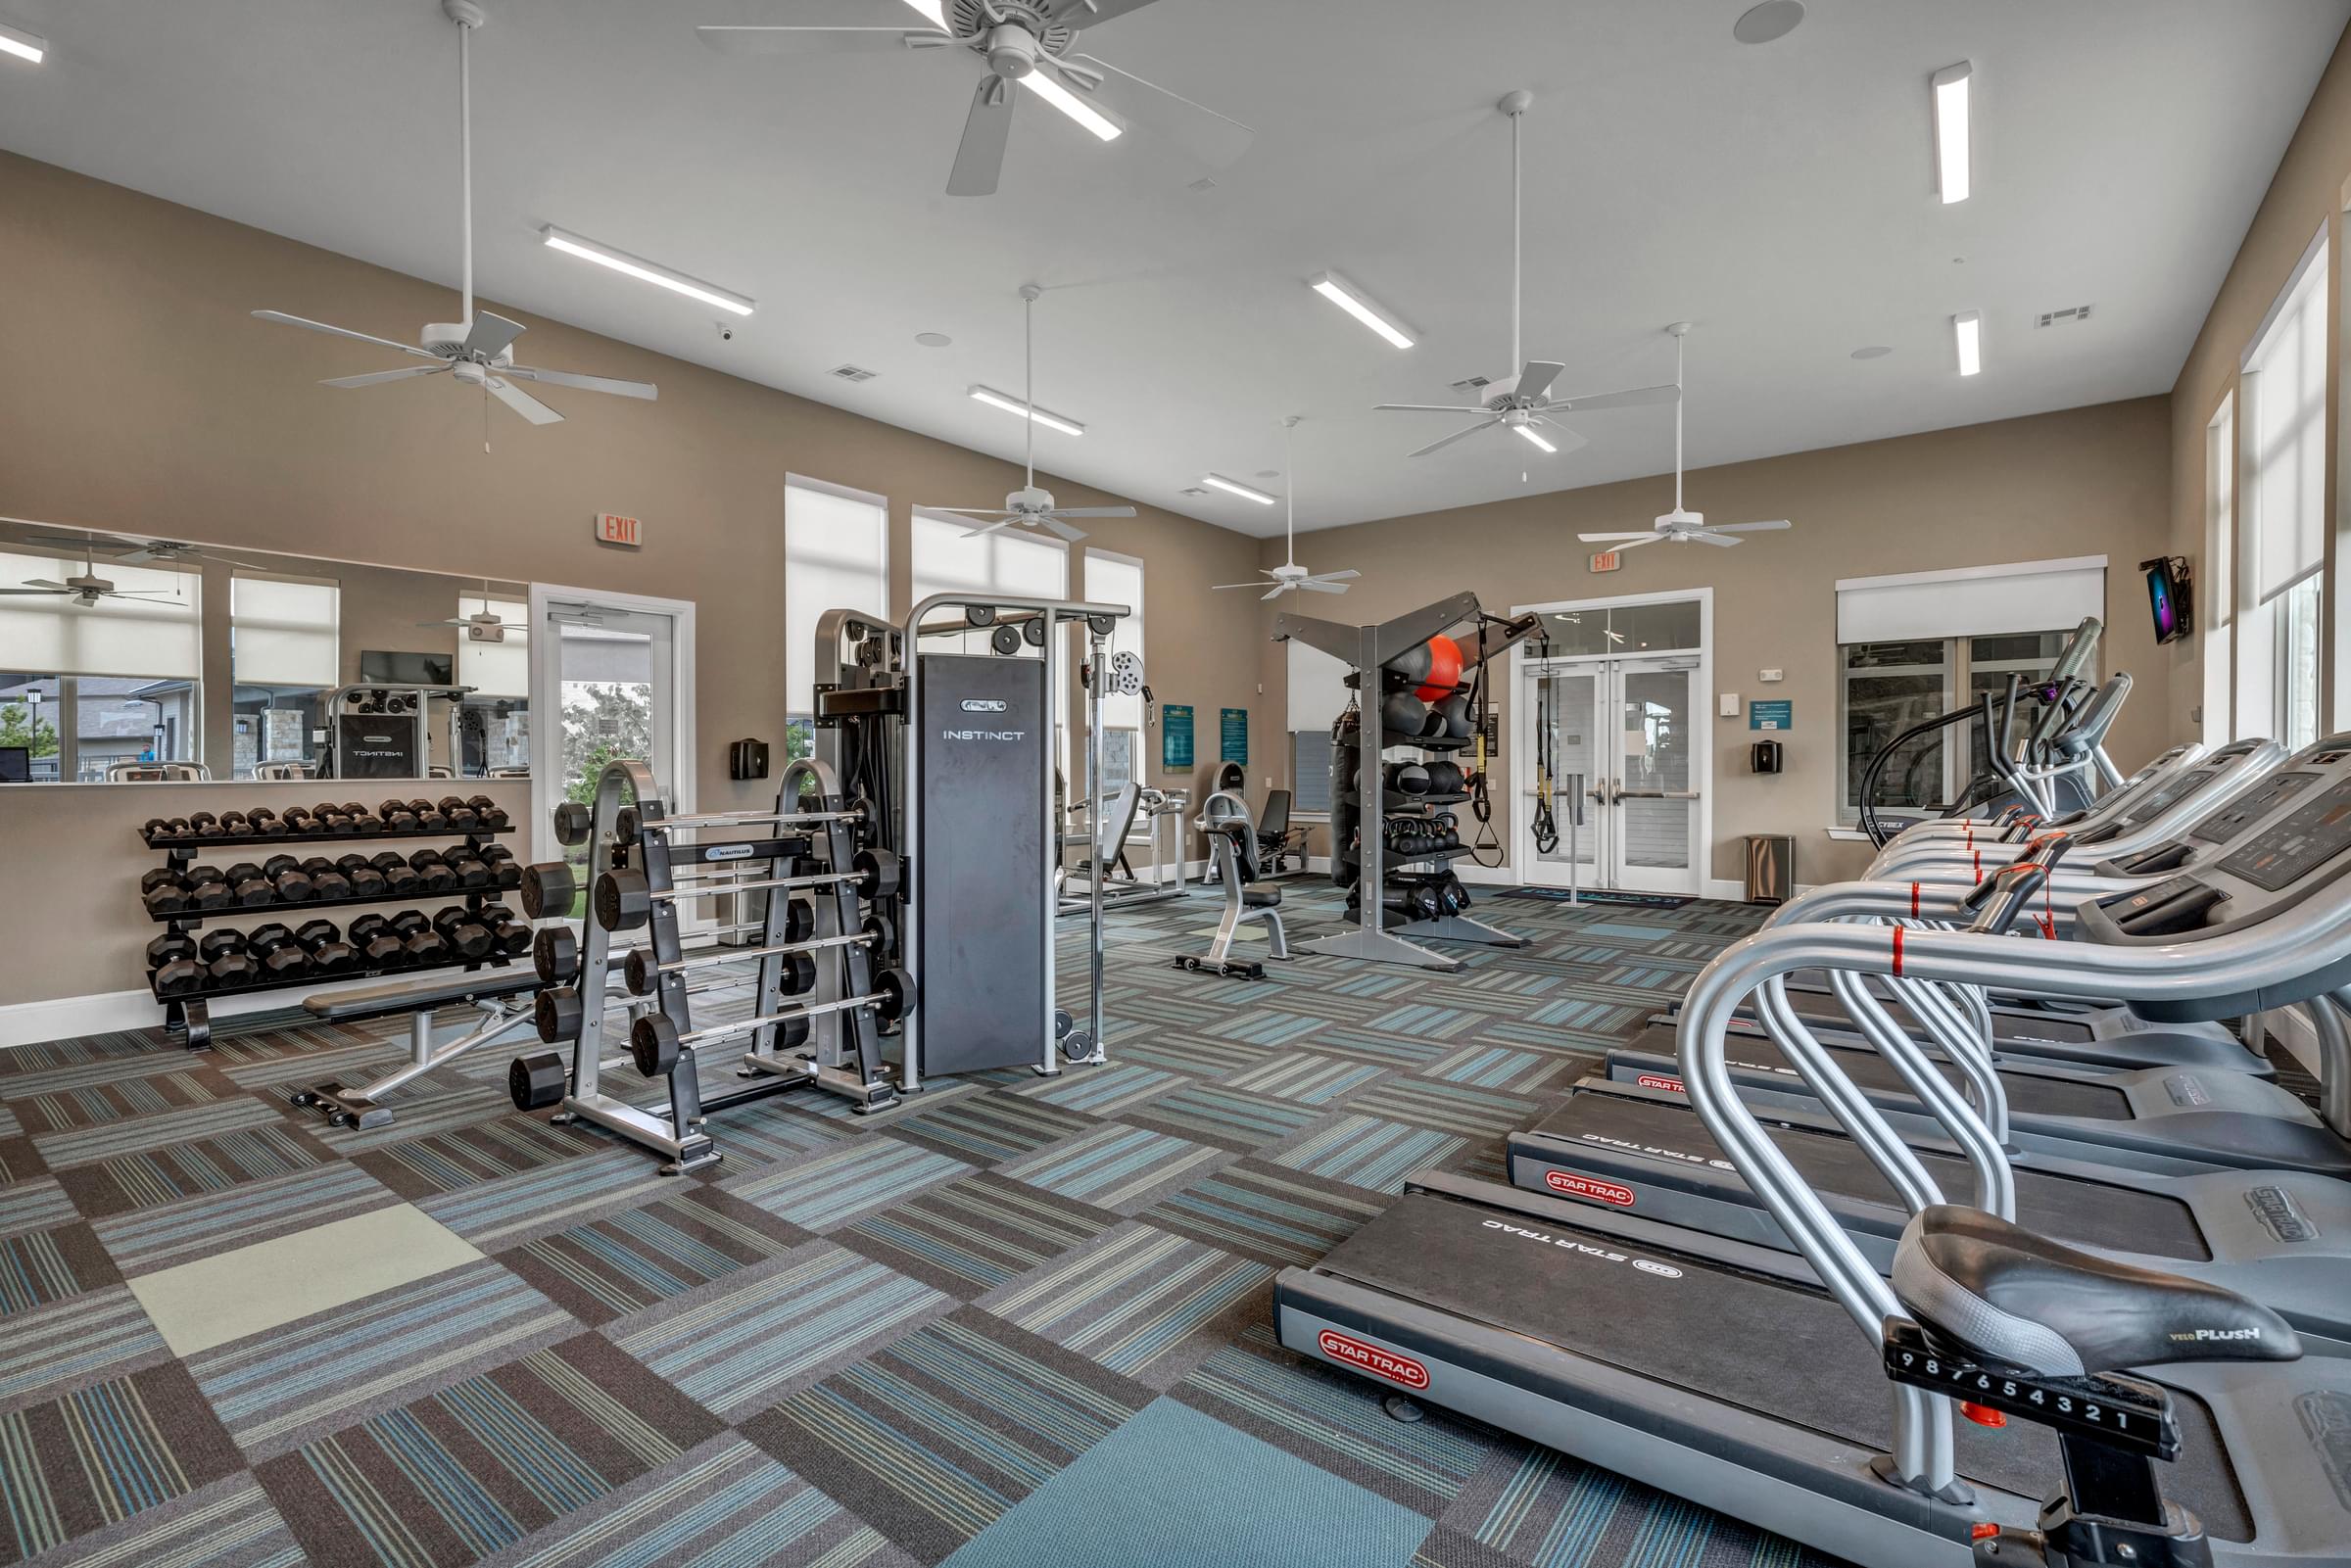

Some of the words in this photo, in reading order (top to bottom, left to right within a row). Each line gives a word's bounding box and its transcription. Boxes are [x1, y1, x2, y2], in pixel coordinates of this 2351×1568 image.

[605, 515, 636, 544] EXIT
[1595, 552, 1615, 571] EXIT
[943, 730, 1026, 741] INSTINCT
[1642, 1078, 1671, 1090] STAR
[1551, 1176, 1587, 1192] STAR
[1588, 1184, 1627, 1201] TRAC
[1482, 1219, 1551, 1243] TRAC
[1555, 1238, 1629, 1262] STAR
[1322, 1338, 1369, 1362] STAR
[1371, 1354, 1420, 1380] TRAC
[1901, 1353, 1914, 1367] 9
[1926, 1359, 1940, 1374] 8
[1977, 1374, 1991, 1389] 6
[2002, 1381, 2017, 1396] 5
[2030, 1390, 2044, 1404] 4
[2057, 1397, 2073, 1412] 3
[2086, 1404, 2101, 1421] 2
[2117, 1412, 2127, 1429] 1
